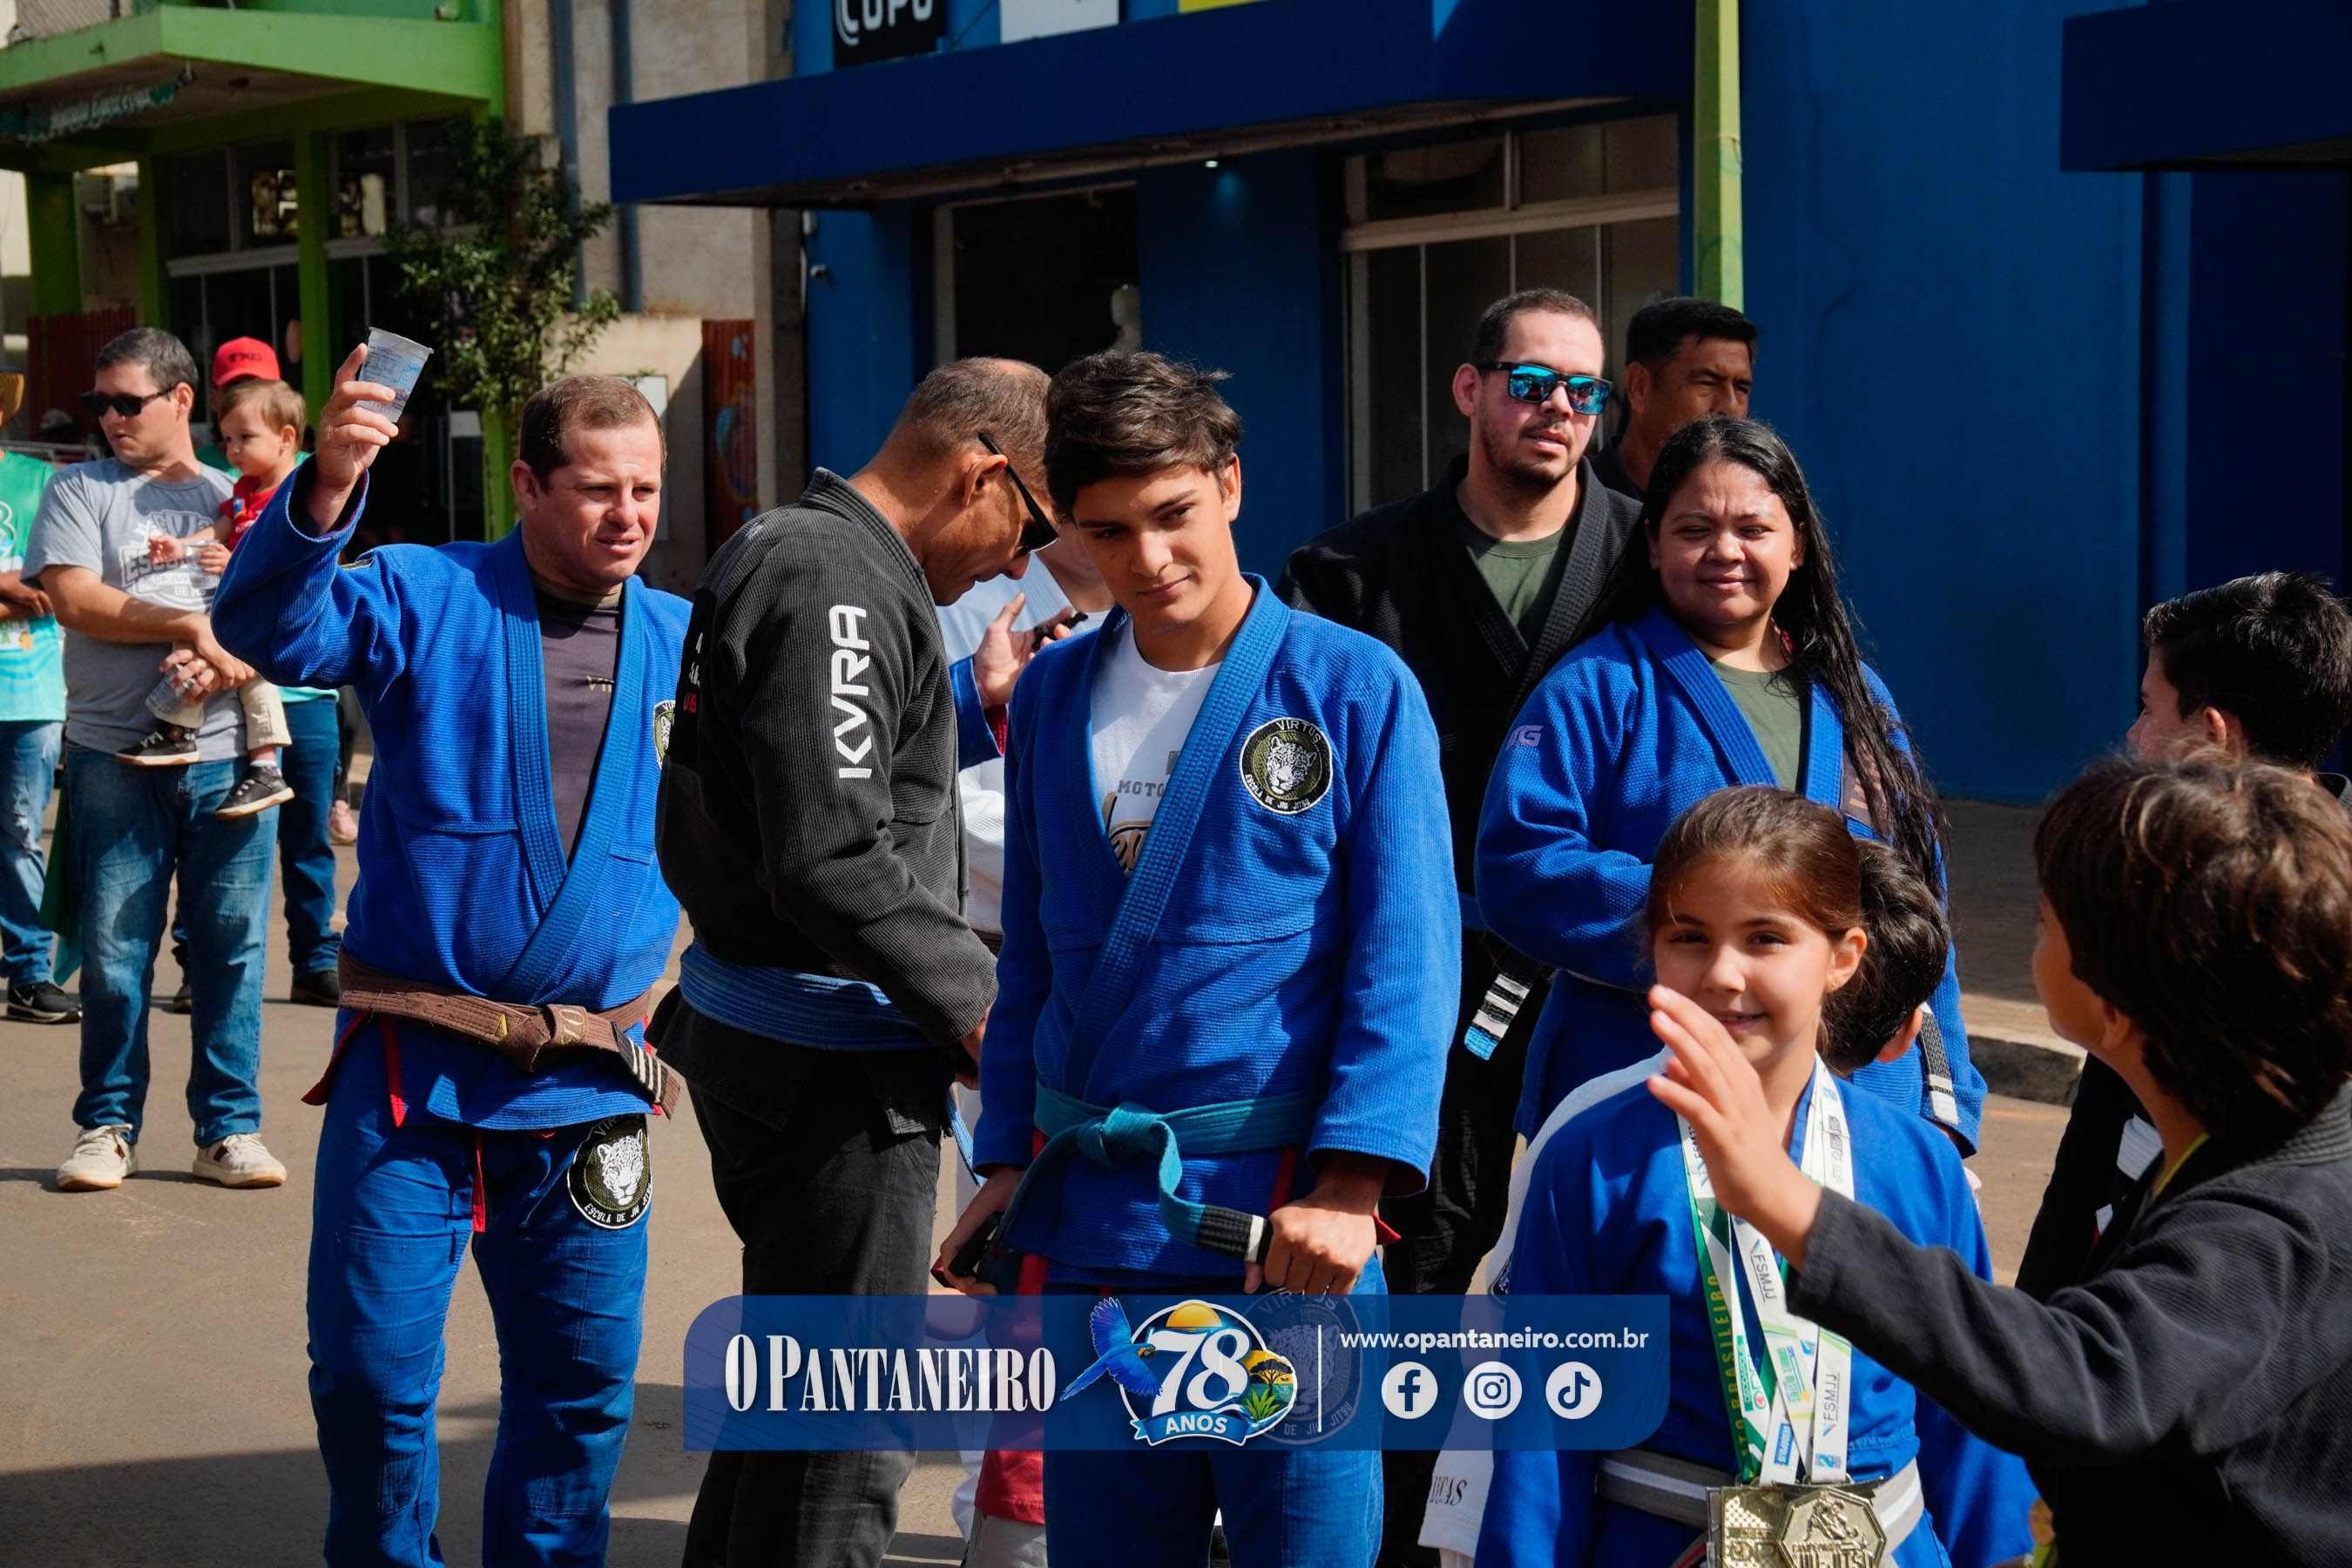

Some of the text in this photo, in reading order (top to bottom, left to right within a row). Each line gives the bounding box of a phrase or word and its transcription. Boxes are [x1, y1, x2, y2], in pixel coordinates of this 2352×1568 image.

[828, 605, 872, 779] KVRA
[1275, 720, 1321, 743] VIRTUS
[1245, 774, 1263, 798] ESCOLA
[1265, 795, 1275, 805] DE
[1293, 798, 1311, 810] JITSU
[584, 1202, 612, 1224] ESCOLA
[616, 1212, 626, 1223] DE
[1753, 1254, 1777, 1301] FSMJJ
[1707, 1274, 1741, 1409] BRASILEIRO
[1823, 1373, 1838, 1422] FSMJJ
[1284, 1423, 1297, 1436] DE
